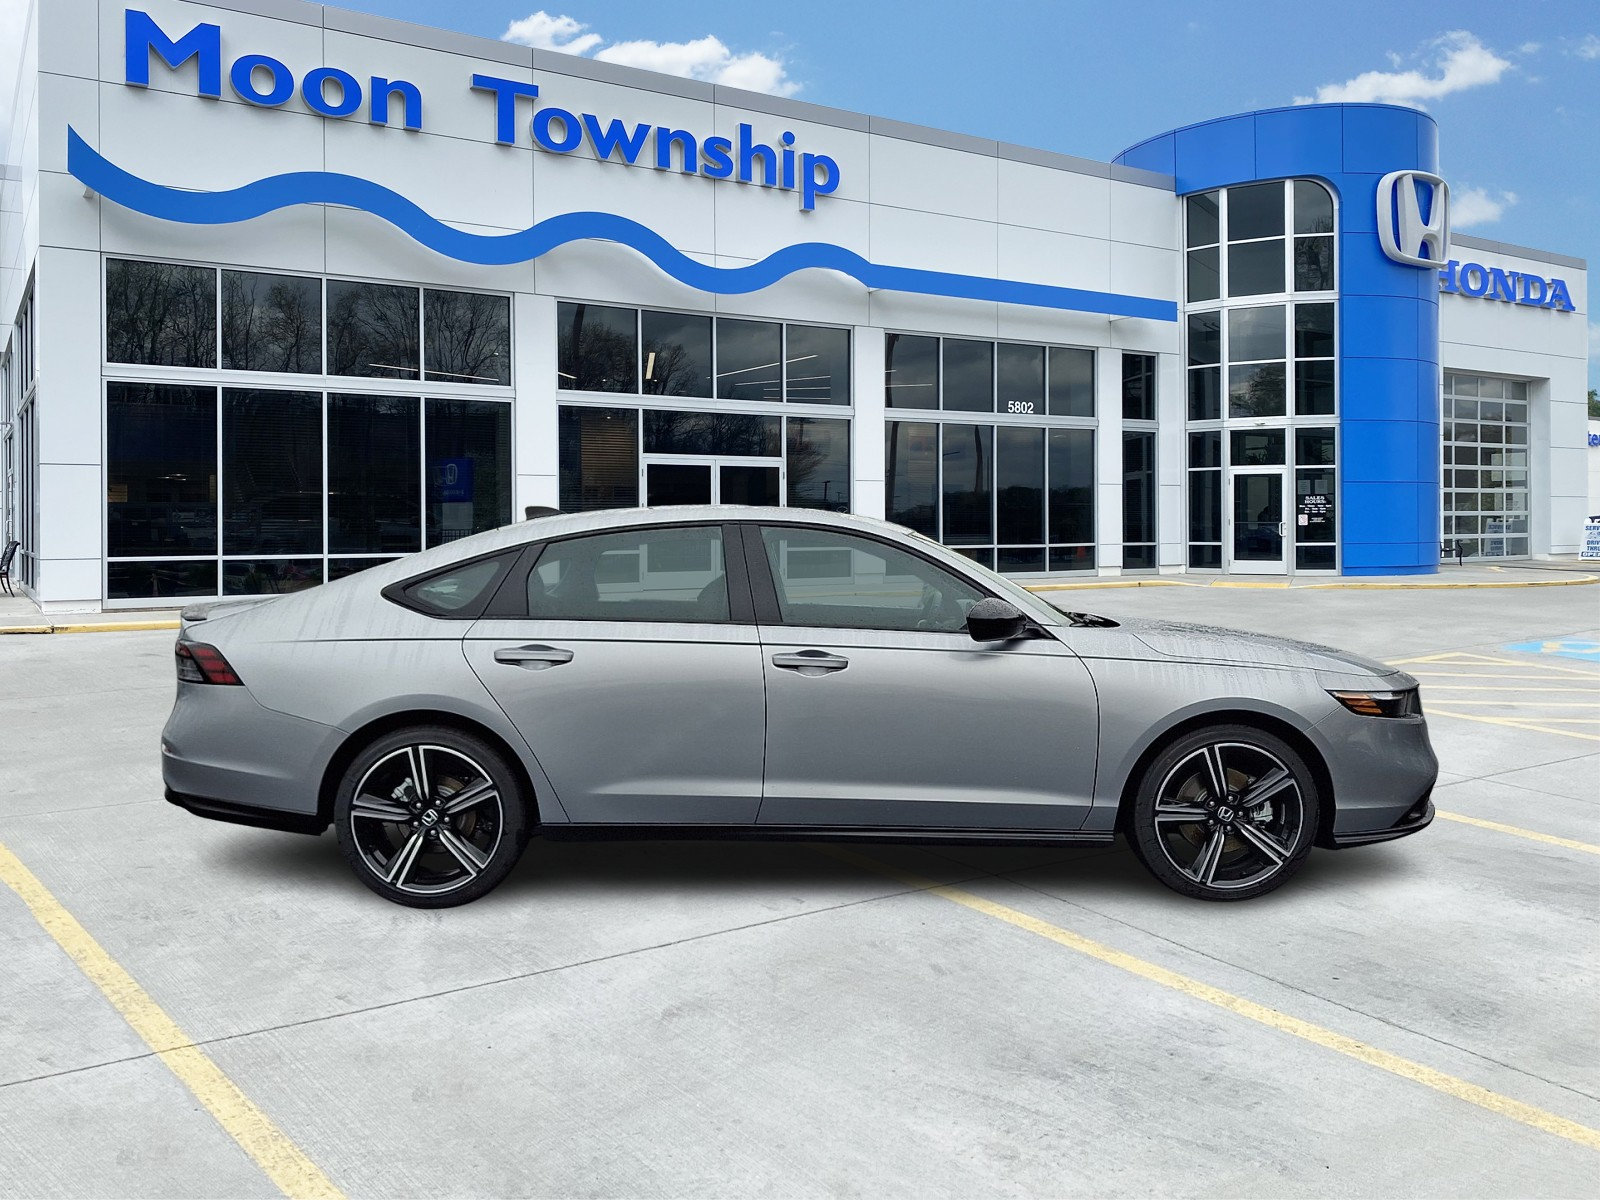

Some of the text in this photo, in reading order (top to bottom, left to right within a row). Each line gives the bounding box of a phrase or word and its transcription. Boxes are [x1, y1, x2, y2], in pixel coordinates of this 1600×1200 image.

[125, 8, 841, 212] Moon Township
[1007, 400, 1034, 414] 5802
